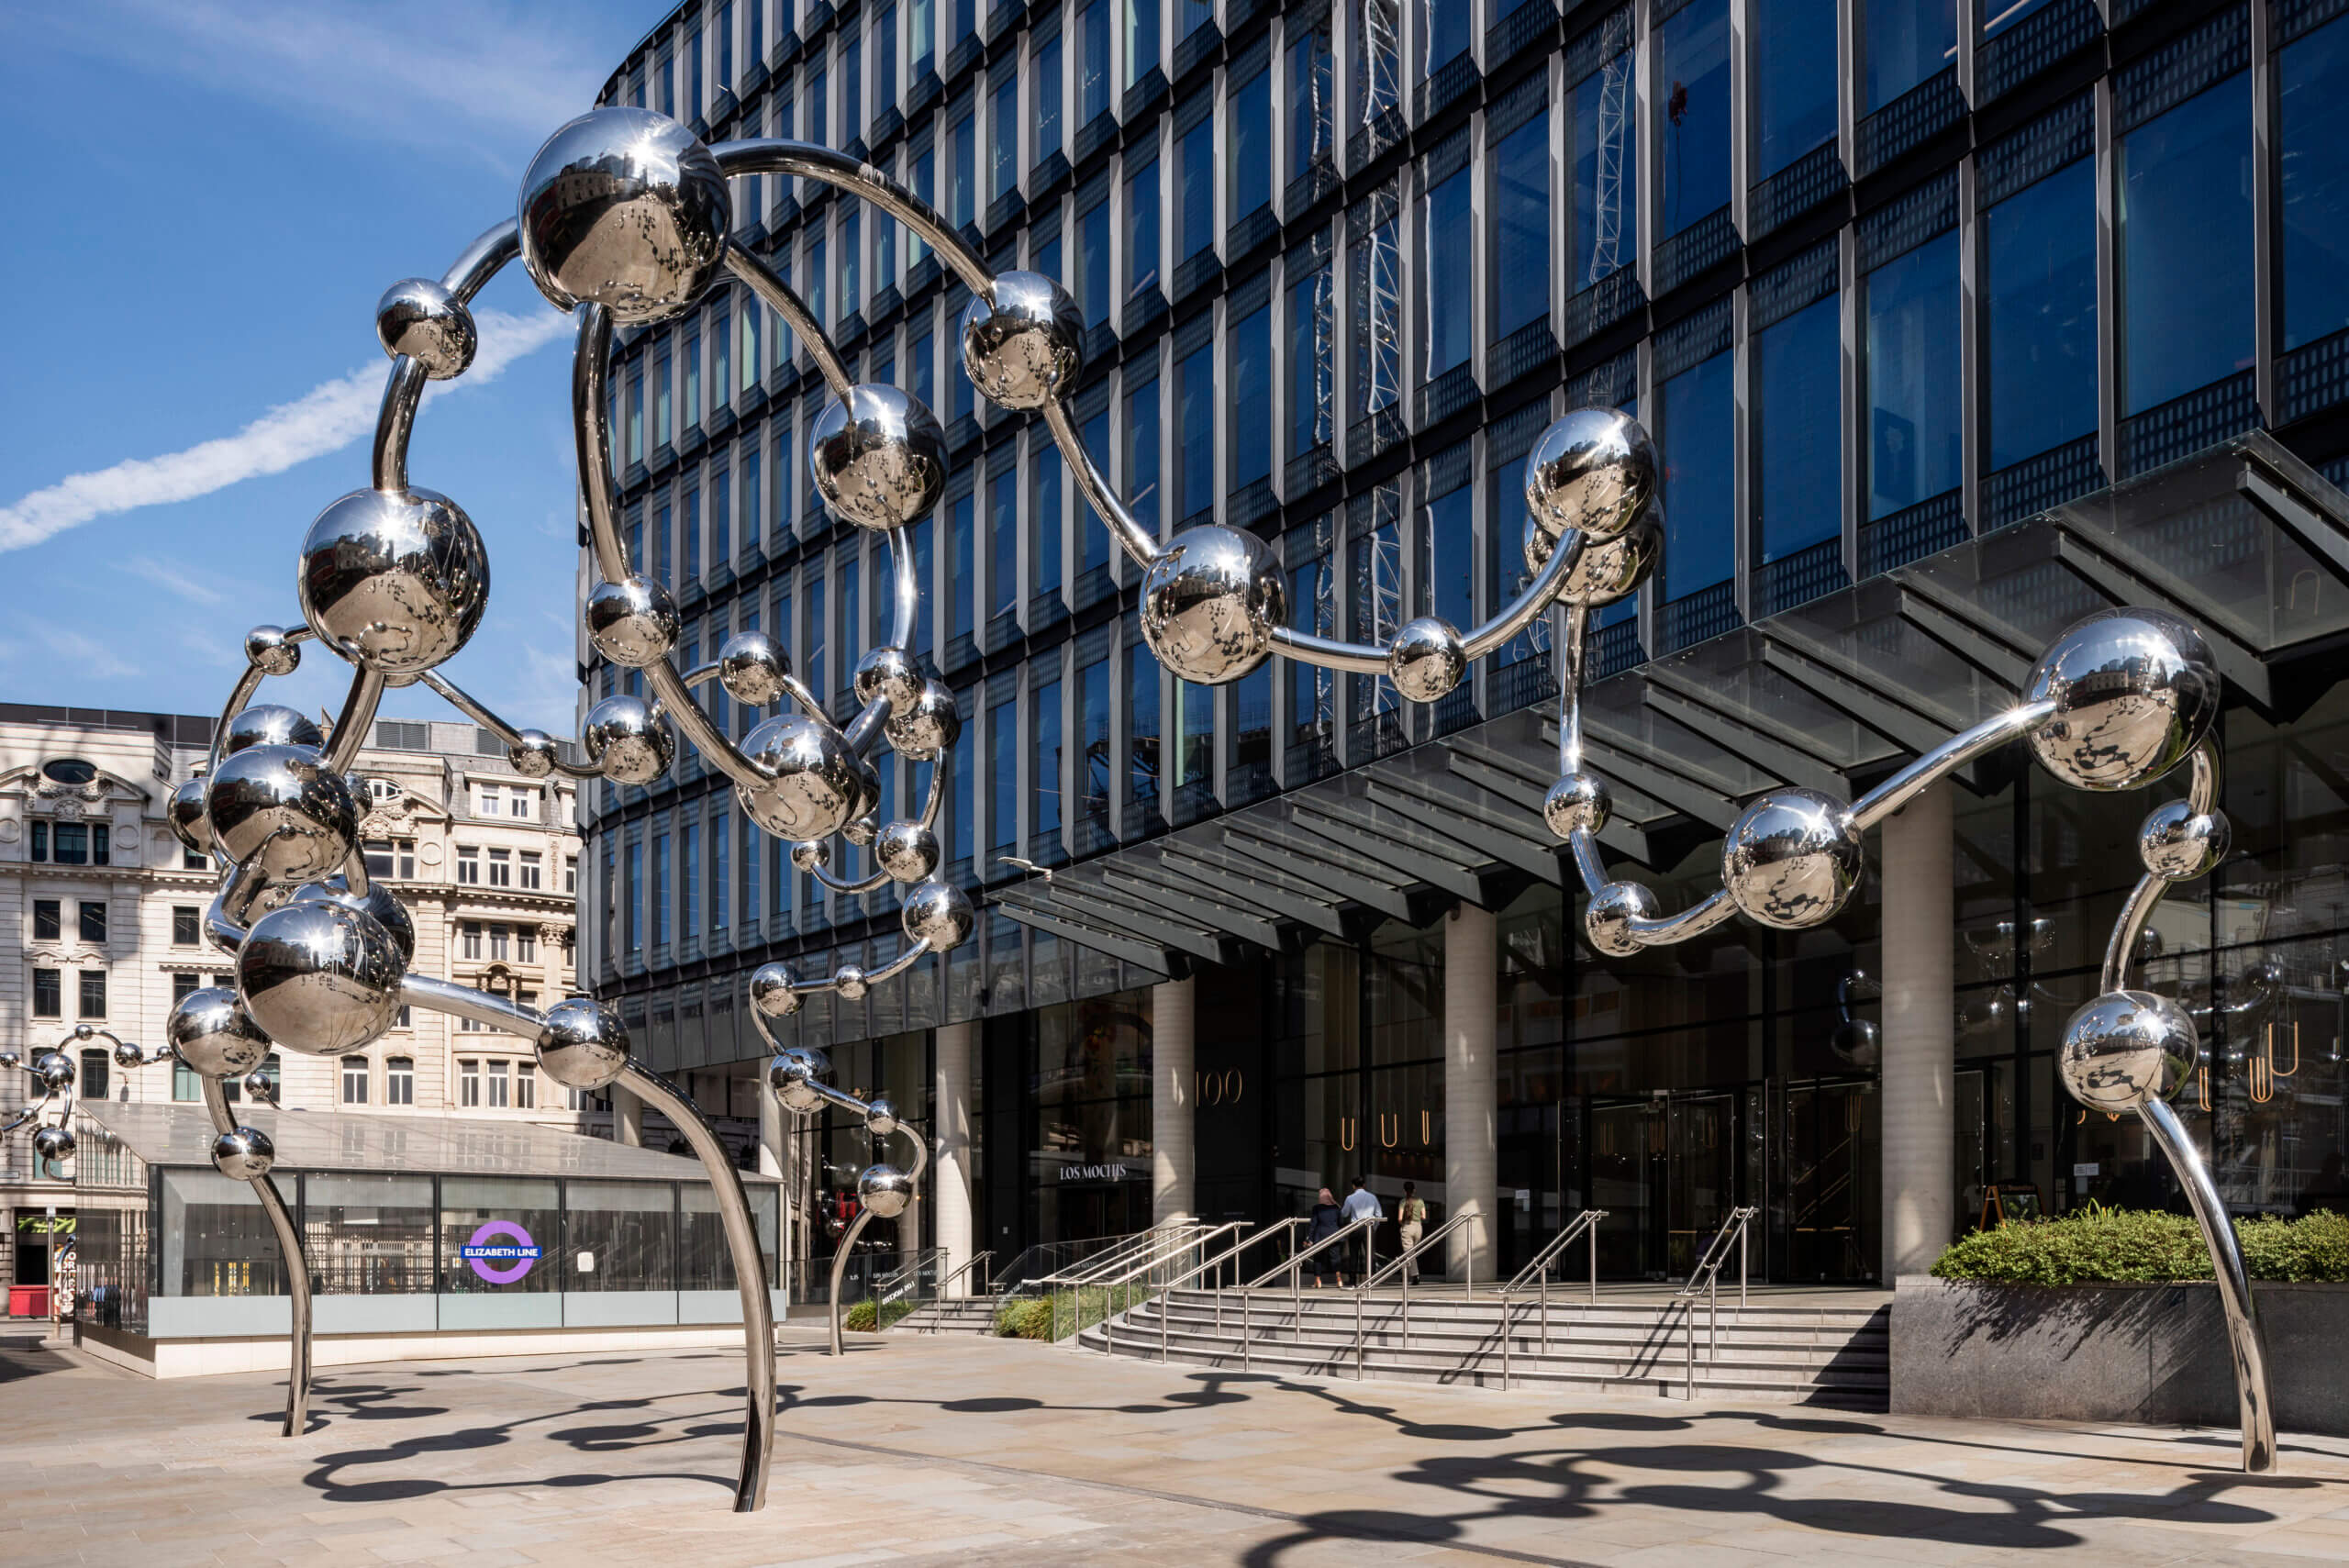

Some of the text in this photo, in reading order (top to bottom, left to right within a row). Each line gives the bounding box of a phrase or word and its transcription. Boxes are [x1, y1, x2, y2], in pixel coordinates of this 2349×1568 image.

[1196, 1071, 1242, 1107] 100
[1060, 1163, 1127, 1181] LOS MOCHIS
[464, 1248, 539, 1257] ELIZABETH LINE
